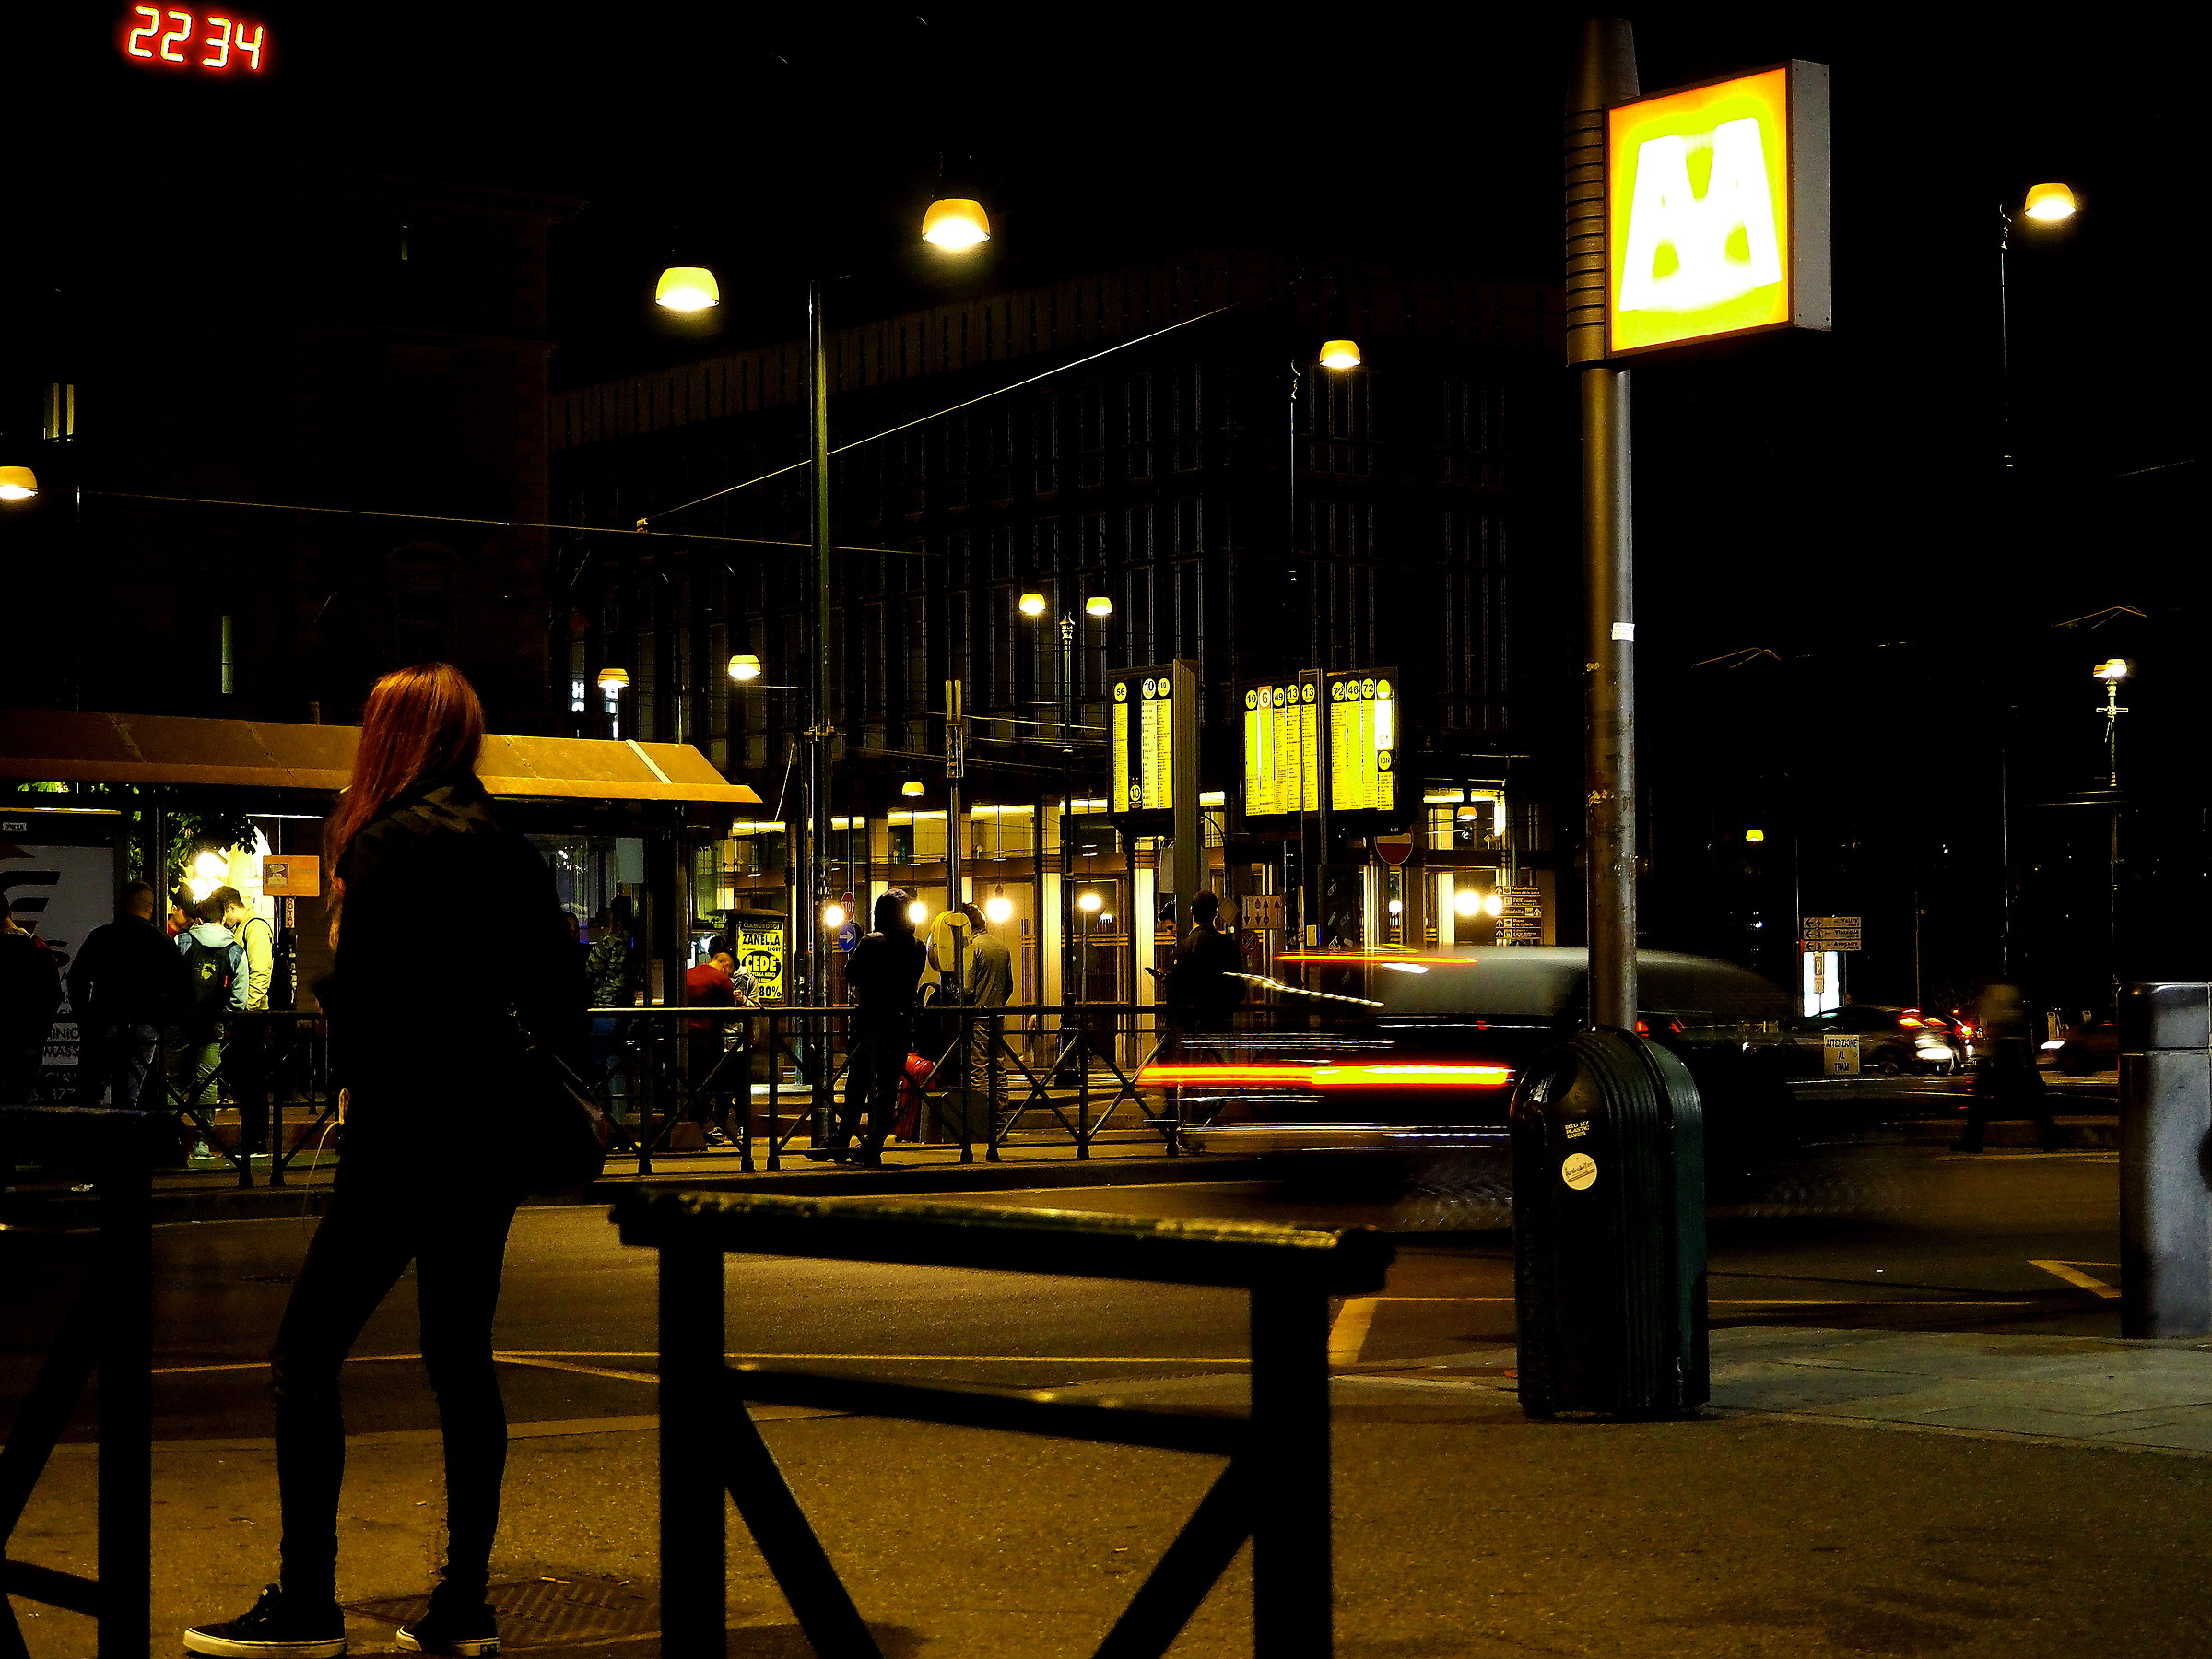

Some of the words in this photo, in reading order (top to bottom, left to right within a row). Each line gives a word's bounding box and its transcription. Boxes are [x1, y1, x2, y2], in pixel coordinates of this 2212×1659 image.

[128, 6, 193, 63] 22
[202, 17, 264, 70] 34
[1144, 680, 1155, 692] 10
[1348, 685, 1359, 695] 46
[1362, 683, 1374, 693] 72
[1116, 688, 1125, 697] 56
[1275, 693, 1284, 701] 49
[1288, 688, 1298, 699] 13
[1304, 687, 1314, 698] 13
[1247, 694, 1257, 703] 10
[1262, 692, 1268, 704] 6
[1131, 788, 1140, 799] 10
[742, 933, 781, 946] ZANELLA
[745, 955, 777, 971] CEDE
[1825, 1038, 1859, 1048] ATTENZIONE
[1838, 1050, 1845, 1060] AL
[1833, 1062, 1850, 1072] TRAM
